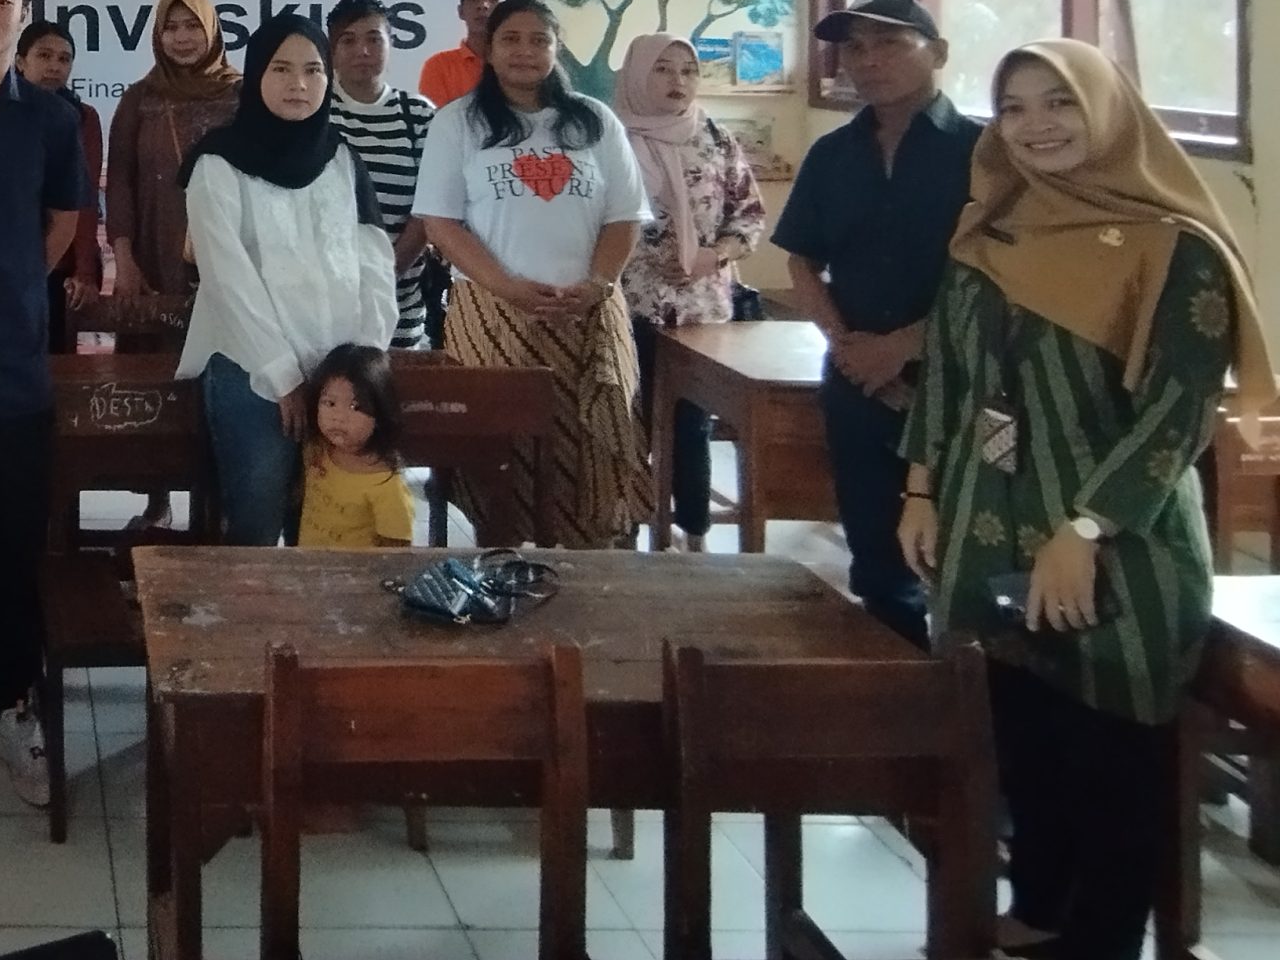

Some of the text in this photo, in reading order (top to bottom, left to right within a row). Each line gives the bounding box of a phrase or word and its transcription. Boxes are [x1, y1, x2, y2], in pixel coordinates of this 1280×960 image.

[511, 146, 569, 162] PAST
[486, 160, 596, 182] PRESENT
[492, 178, 593, 200] FUTURE
